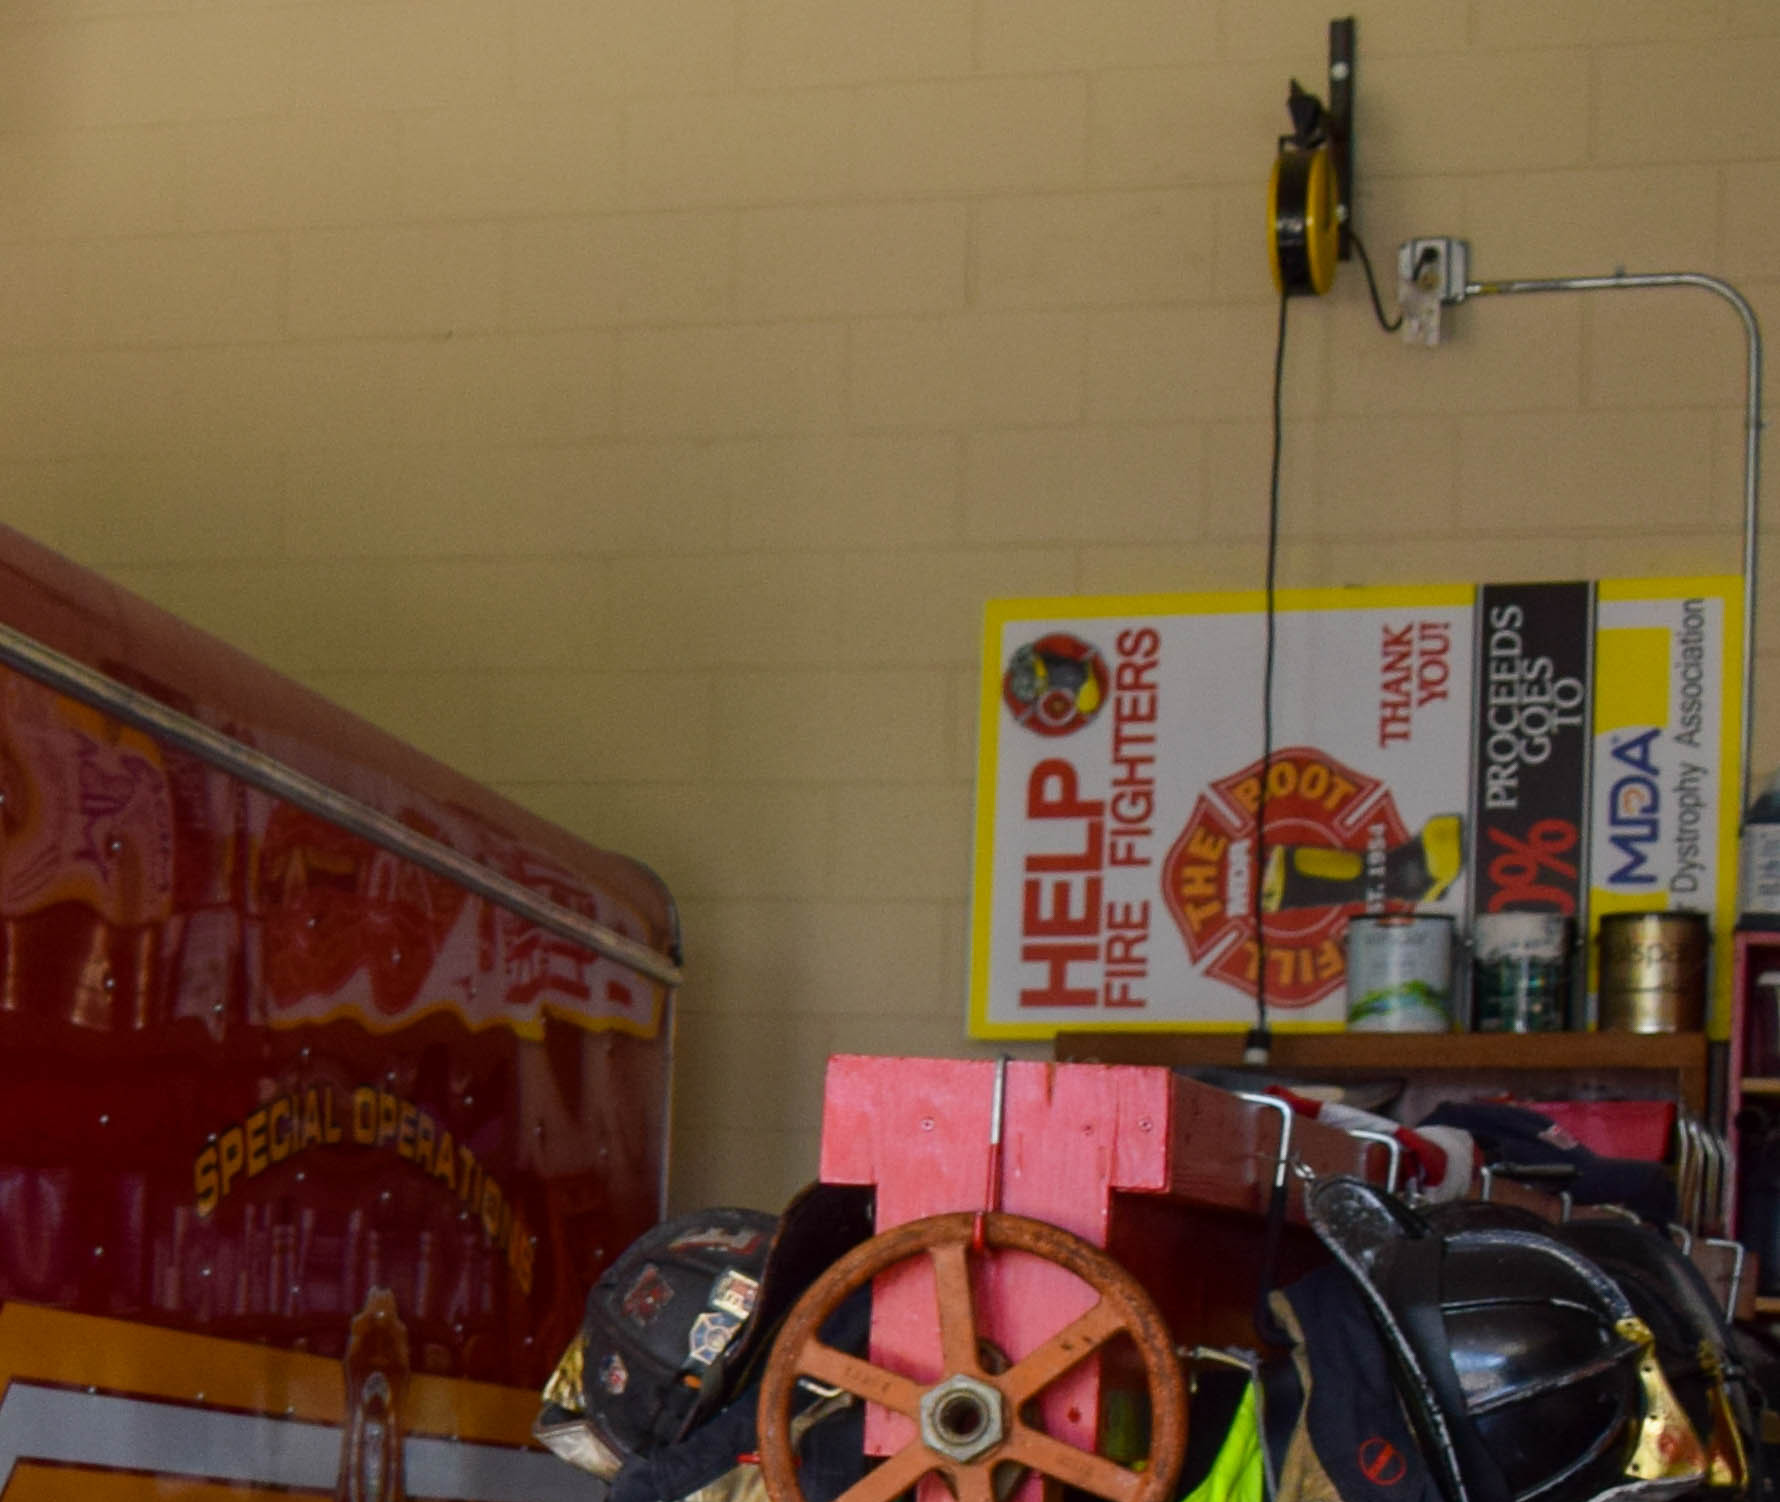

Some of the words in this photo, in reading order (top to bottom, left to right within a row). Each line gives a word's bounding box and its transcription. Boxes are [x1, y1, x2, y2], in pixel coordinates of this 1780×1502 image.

[1379, 620, 1415, 748] THANK
[1417, 621, 1451, 708] YOU!
[1486, 603, 1524, 810] PROCEEDS
[1519, 655, 1555, 766] GOES
[1550, 676, 1585, 729] TO
[1674, 598, 1707, 749] Association
[1107, 627, 1161, 867] FIGHTERS
[1232, 762, 1359, 814] BOOT
[1608, 727, 1661, 884] MDA
[1018, 758, 1105, 1008] HELP
[1182, 826, 1228, 934] THE
[1670, 762, 1708, 894] Dystrophy
[1104, 900, 1151, 1009] FIRE
[193, 1083, 343, 1217] SPECIAL
